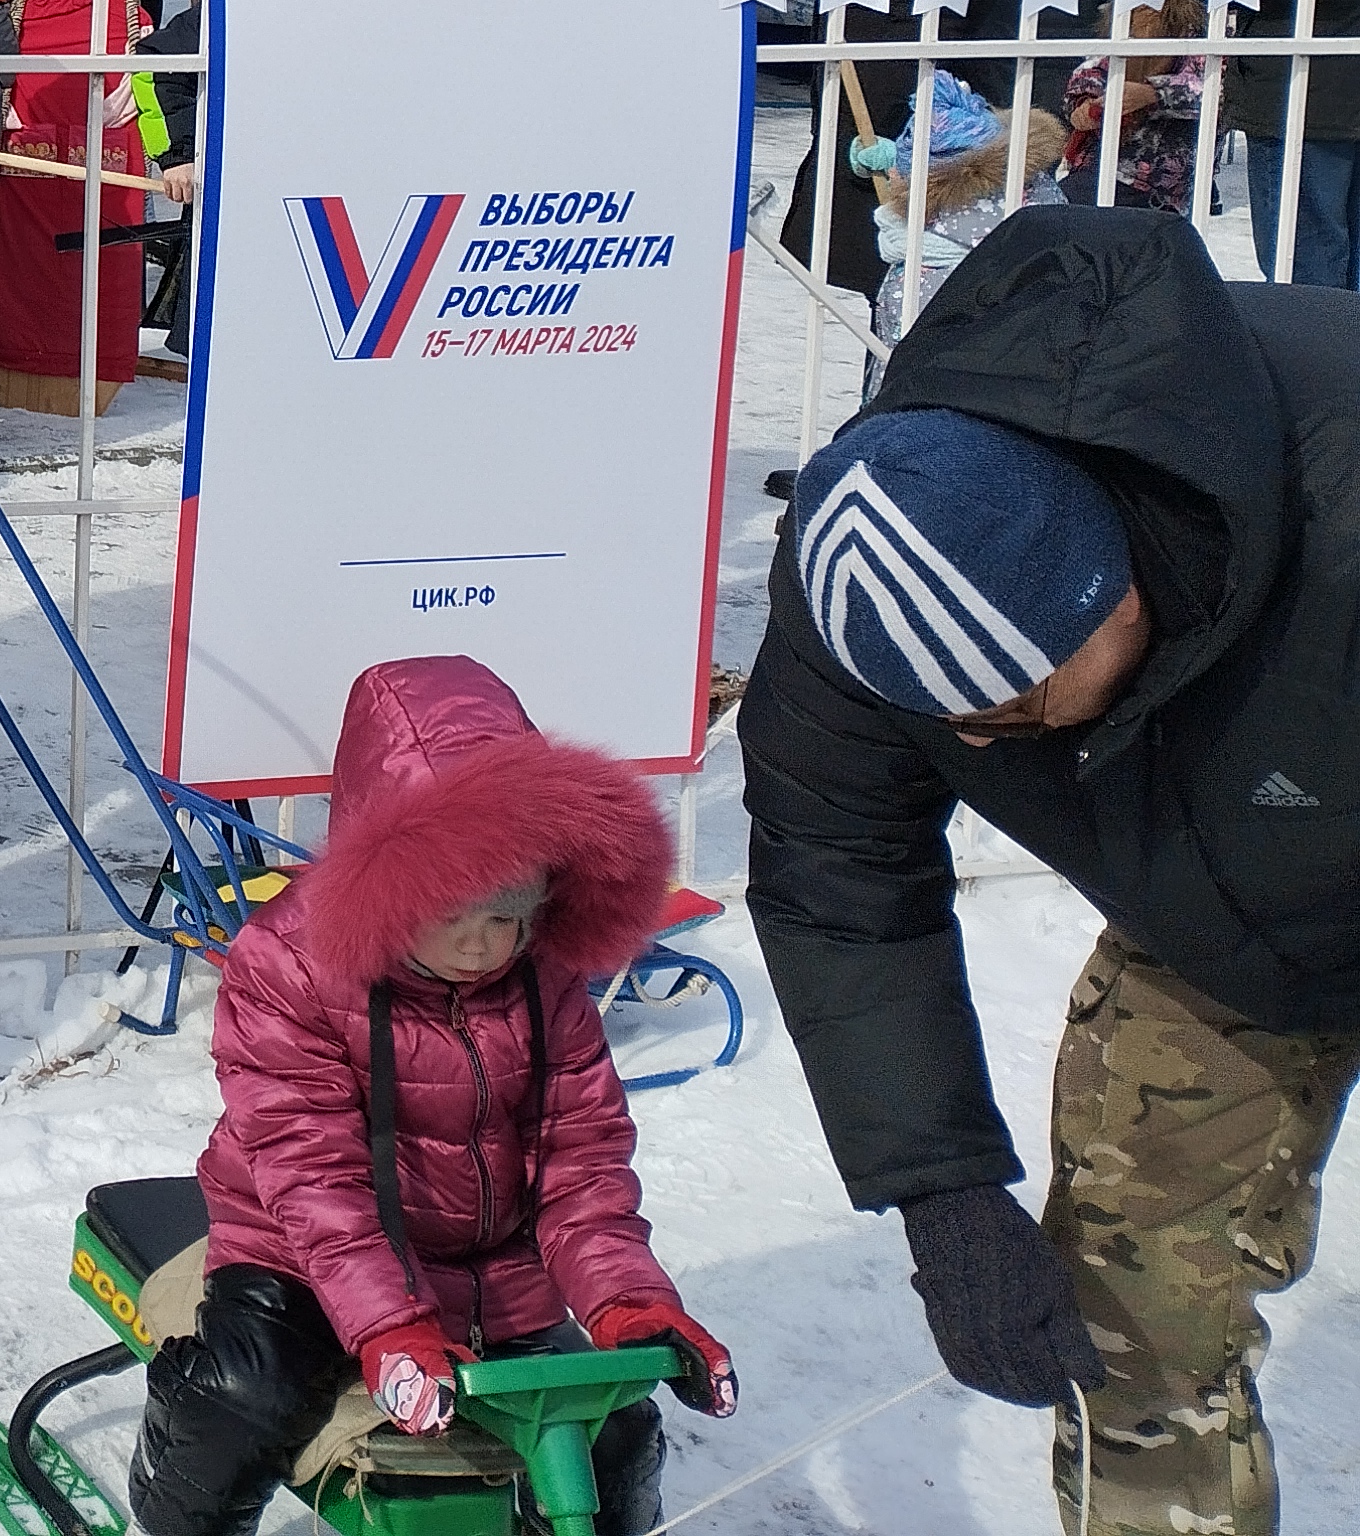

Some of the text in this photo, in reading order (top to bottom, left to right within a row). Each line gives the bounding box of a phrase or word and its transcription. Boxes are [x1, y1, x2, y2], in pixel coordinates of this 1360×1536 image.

[479, 191, 636, 226] ВЫБОРЫ
[458, 235, 675, 274] ПРЕЗИДЕНТА
[437, 283, 581, 318] РОССИИ
[491, 326, 577, 356] МАРТА
[577, 324, 638, 353] 2024
[412, 585, 496, 613] ЦИК.РФ
[1251, 795, 1320, 807] adidas
